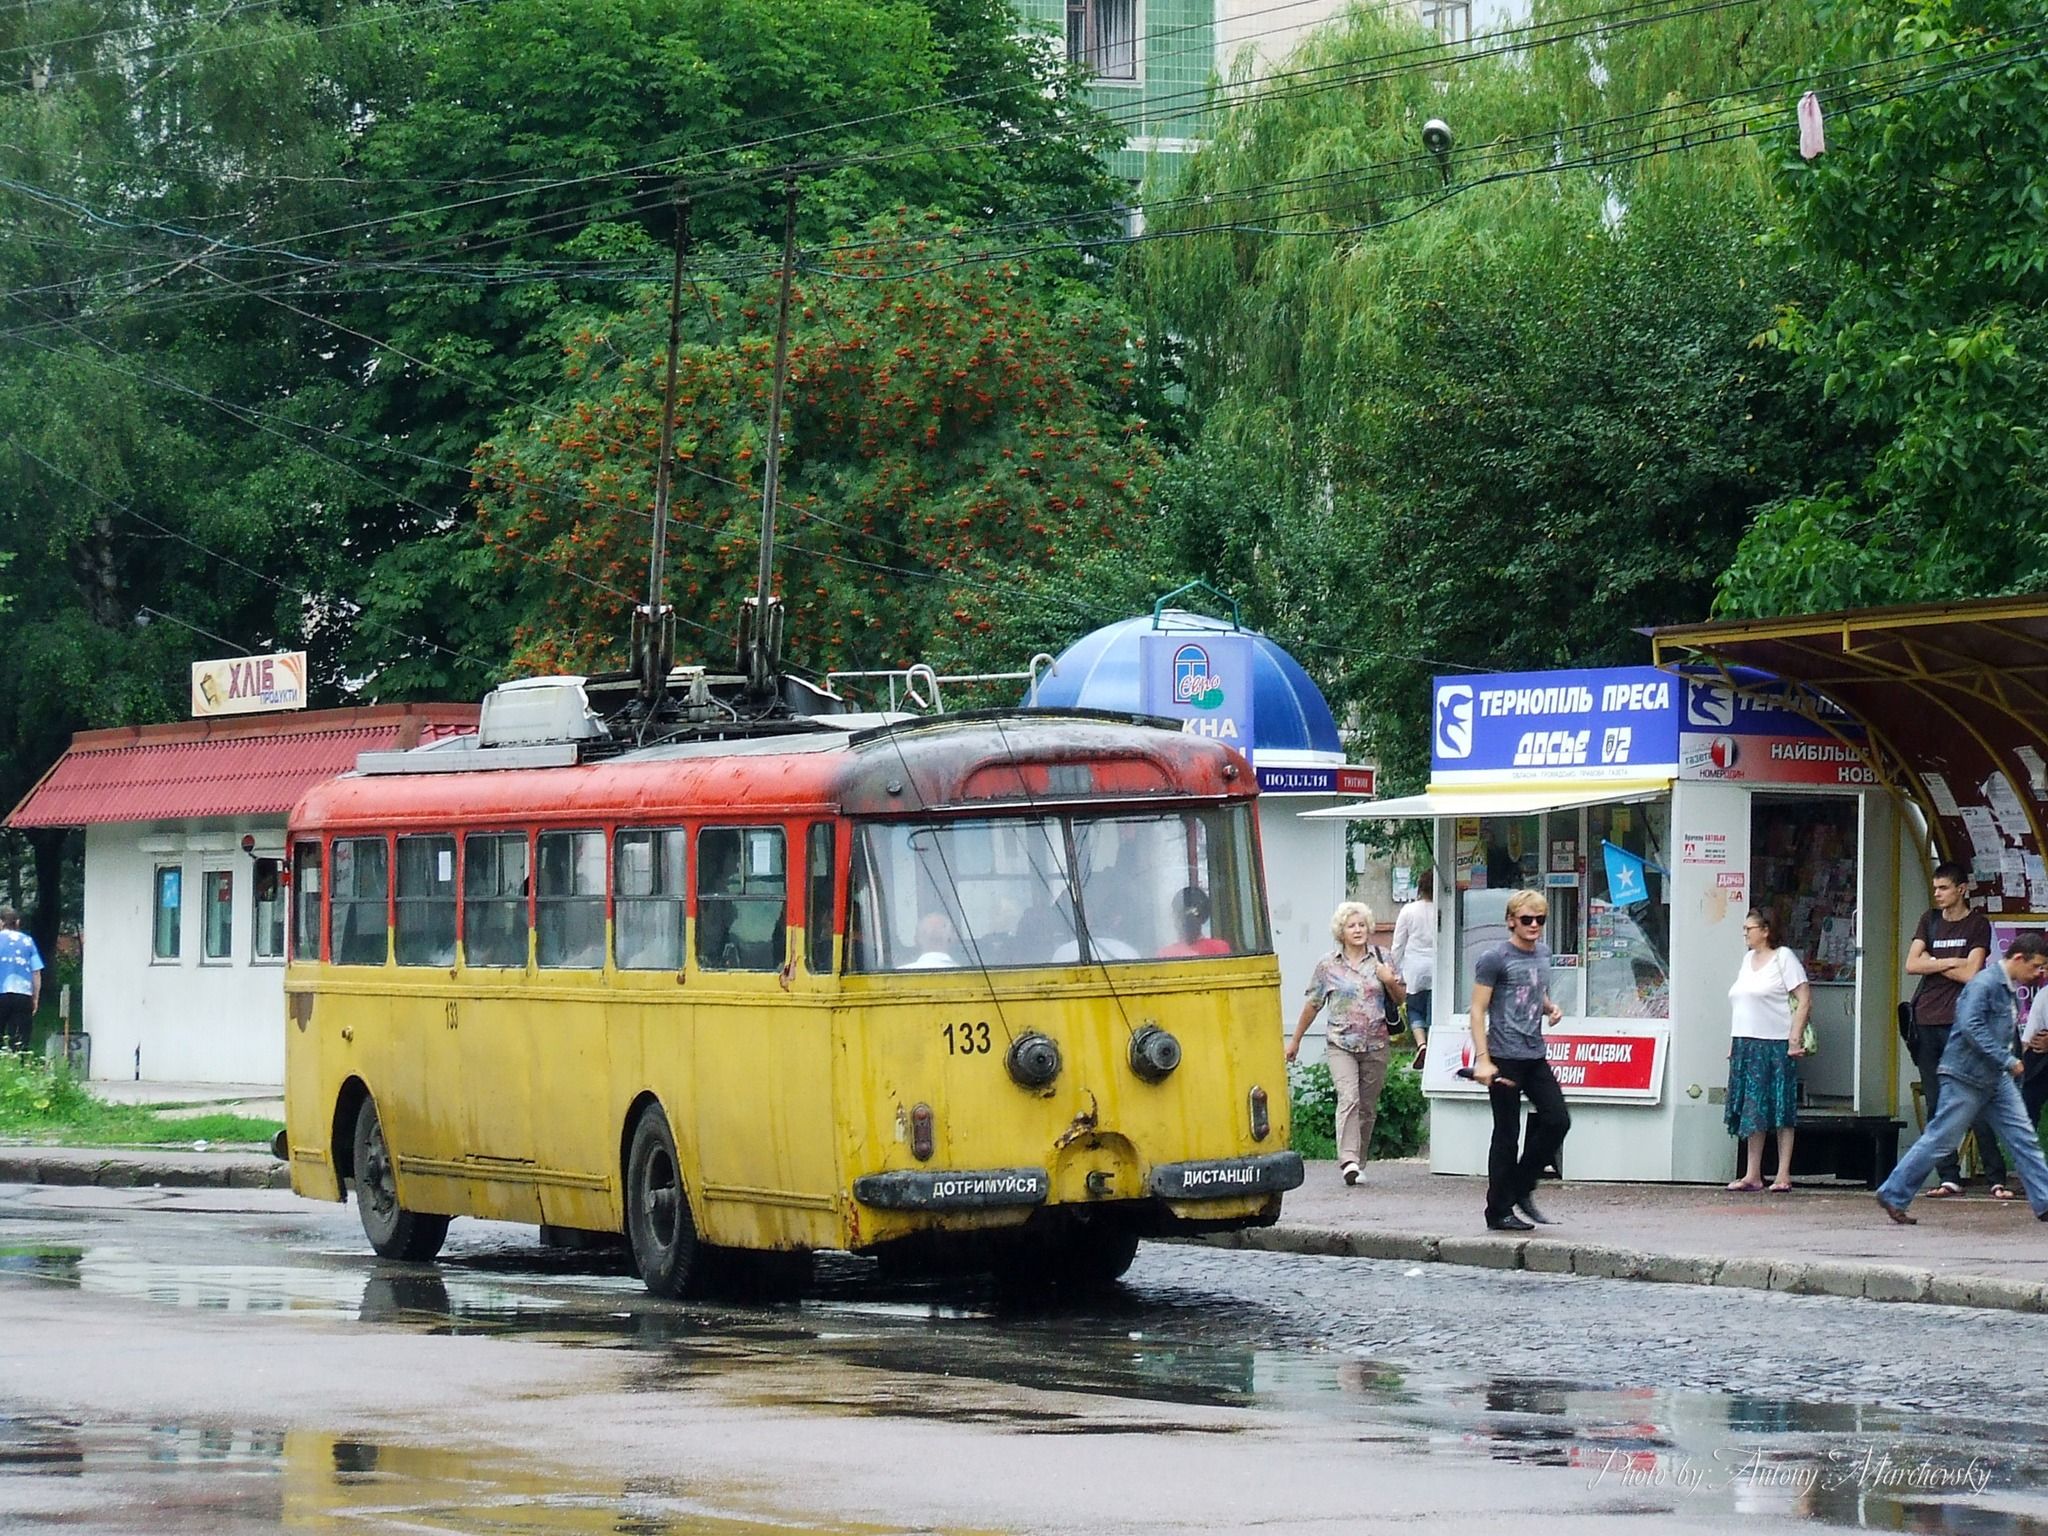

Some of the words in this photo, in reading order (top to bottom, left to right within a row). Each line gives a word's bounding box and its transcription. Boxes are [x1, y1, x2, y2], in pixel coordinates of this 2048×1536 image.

[228, 659, 275, 699] ХЛІБ
[259, 688, 298, 705] ПРОДУКТИ
[1479, 686, 1594, 717] ТЕРНОПІЛЬ
[1601, 682, 1670, 713] ПРЕСА
[1181, 717, 1238, 739] КНА
[1601, 727, 1632, 763] 02
[1265, 773, 1328, 788] ПОДІЛЛЯ
[445, 1001, 459, 1030] 133
[943, 1021, 991, 1055] 133
[1544, 1043, 1571, 1061] ЬШЕ
[1574, 1043, 1633, 1065] МІСЦЕВИХ
[1551, 1065, 1586, 1084] ОВИН
[932, 1177, 1037, 1198] ДОТРИМУЙСЯ
[1182, 1166, 1254, 1188] ДИСТАНЦІЇ
